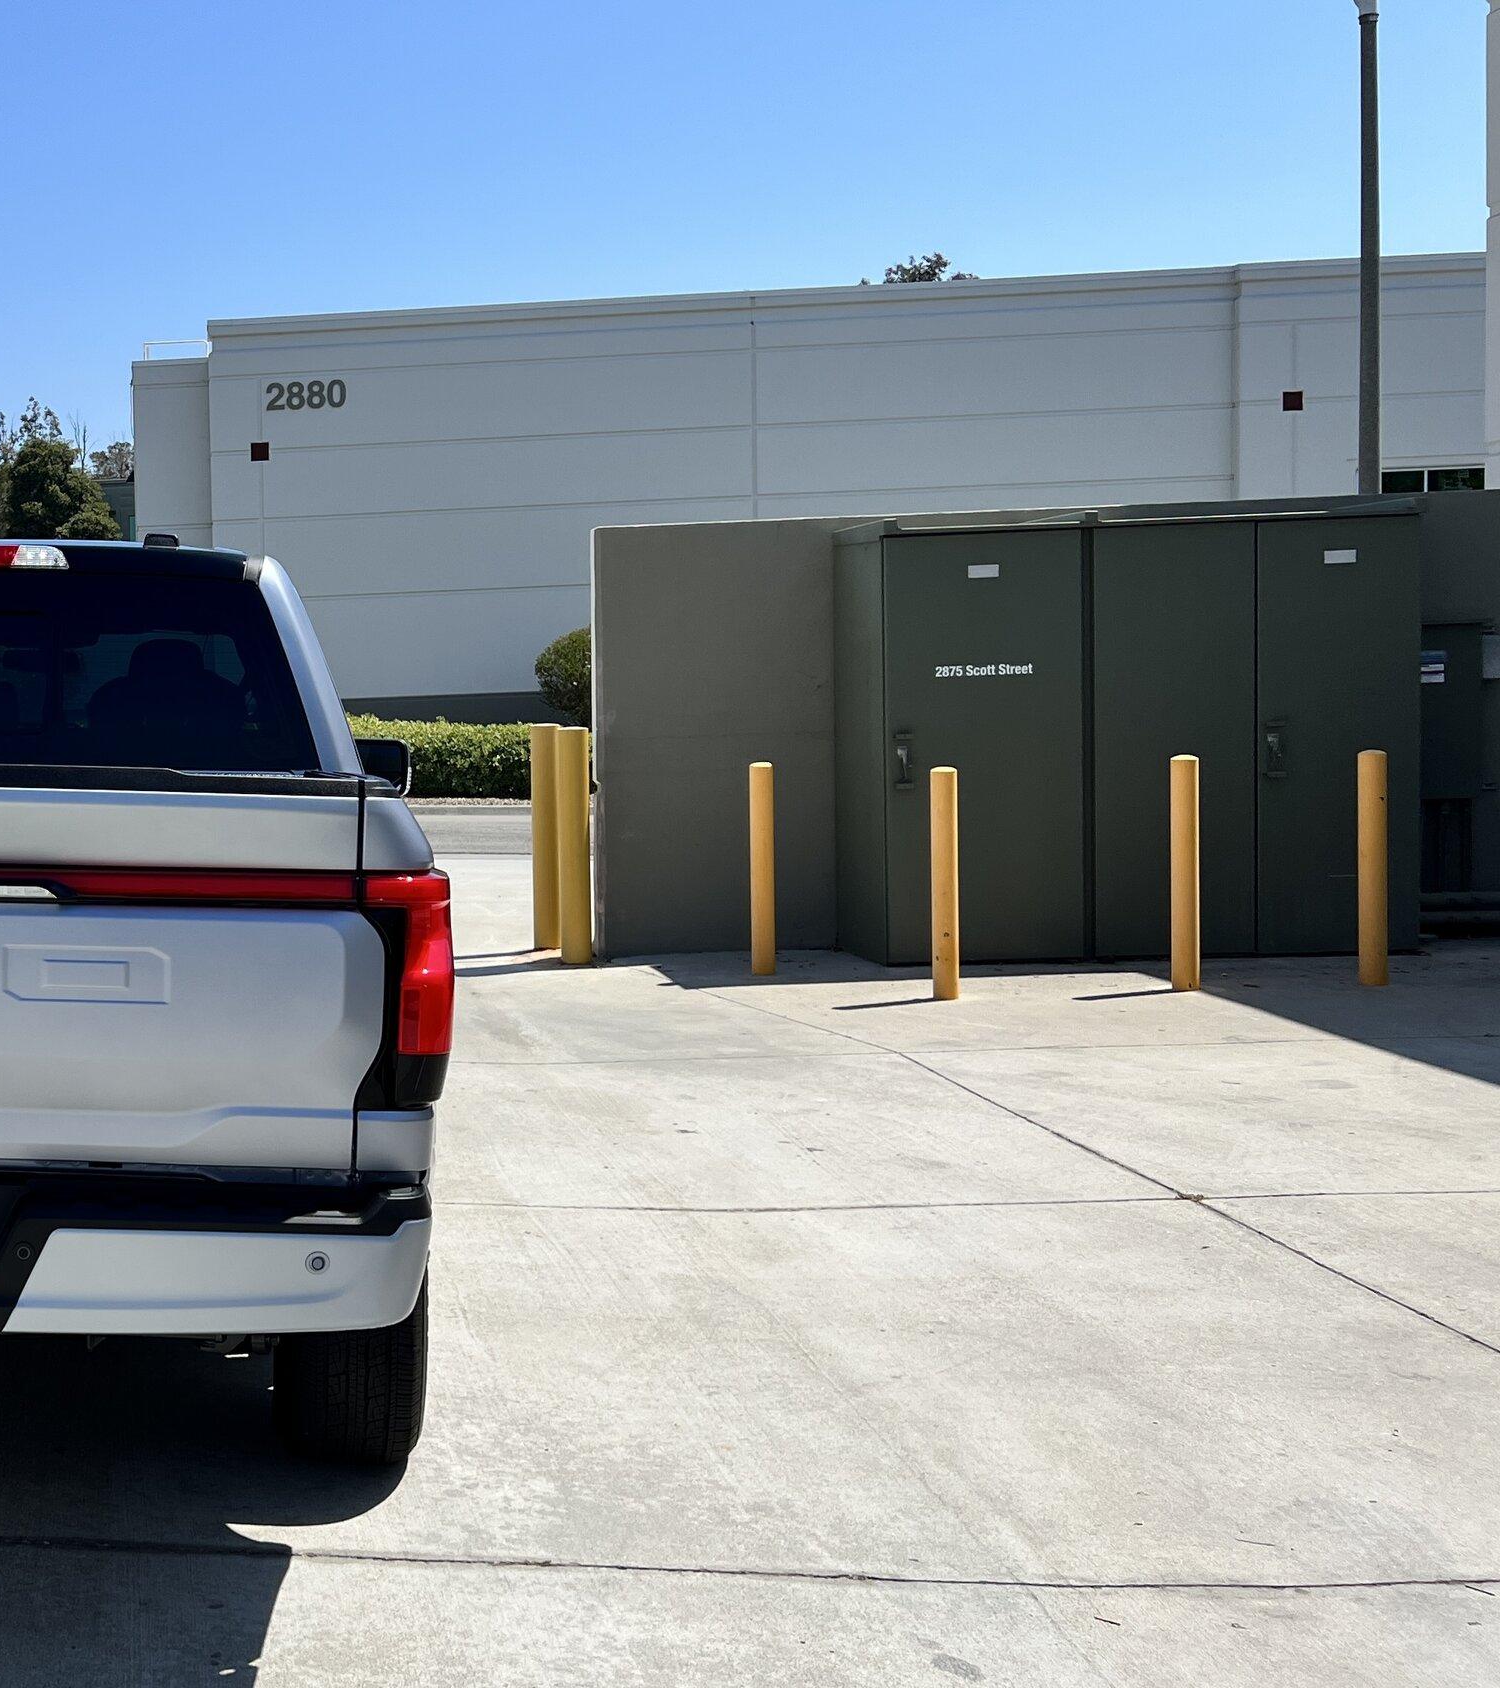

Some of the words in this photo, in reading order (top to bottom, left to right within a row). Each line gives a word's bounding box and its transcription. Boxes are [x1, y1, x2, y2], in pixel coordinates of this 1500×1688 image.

[266, 379, 347, 411] 2880
[935, 665, 963, 677] 2875
[965, 664, 996, 676] Scott
[998, 663, 1033, 675] Street
